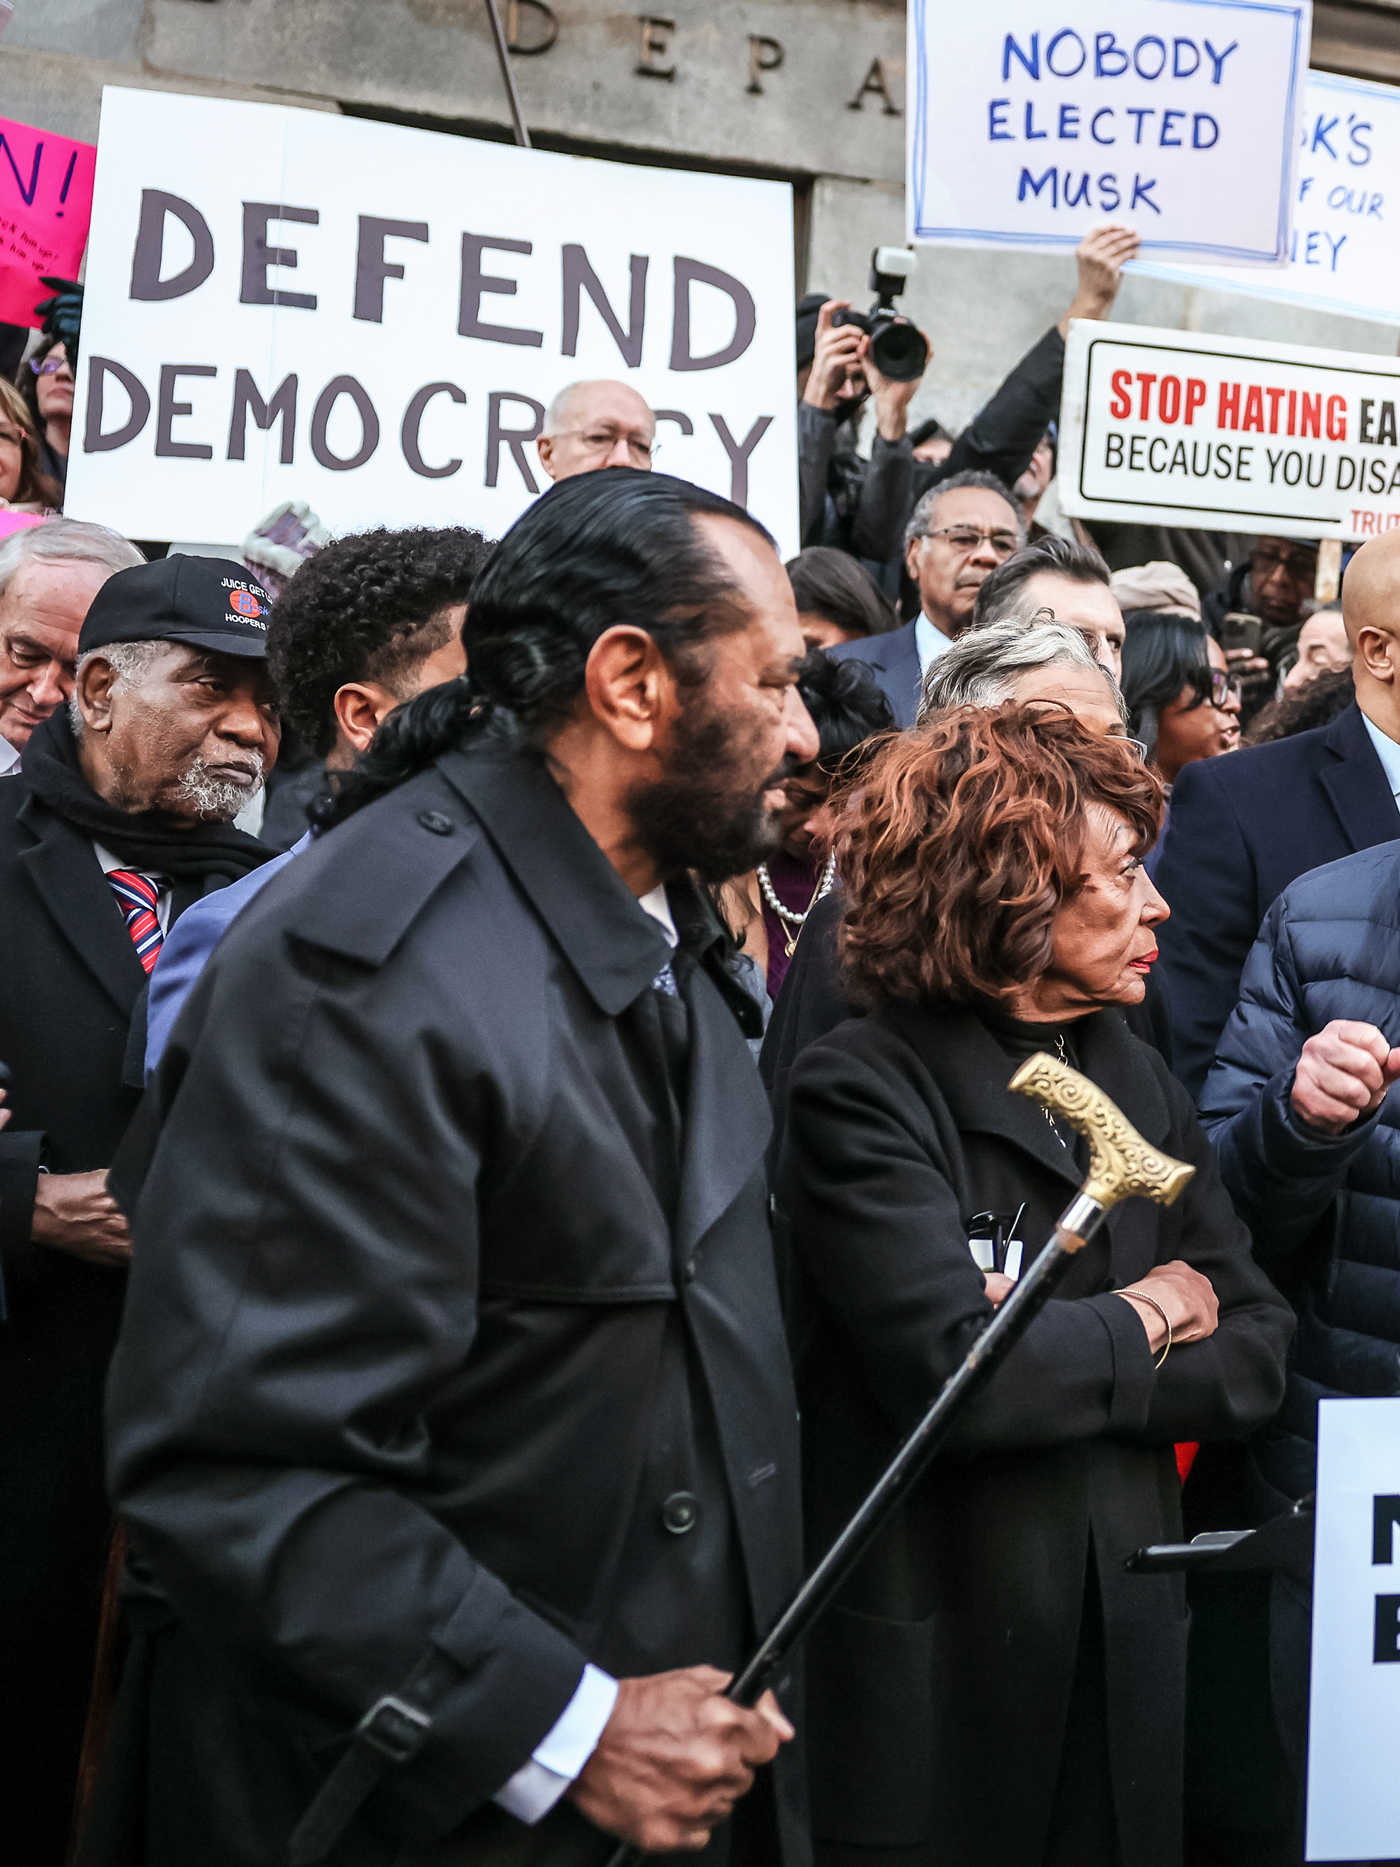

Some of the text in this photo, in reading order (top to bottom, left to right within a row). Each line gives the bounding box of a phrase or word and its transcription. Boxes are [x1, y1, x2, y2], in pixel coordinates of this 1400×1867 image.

[1001, 27, 1237, 85] NOBODY
[988, 98, 1219, 149] ELECTED
[1301, 113, 1372, 167] K'S
[1017, 167, 1160, 213] MUSK
[1327, 185, 1385, 222] OUR
[1291, 229, 1347, 272] EY
[129, 188, 756, 372] DEFEND
[83, 355, 775, 510] DEMOCRY
[1109, 368, 1207, 426] STOP
[1217, 380, 1348, 442] HATING
[1105, 433, 1254, 482] BECAUSE
[1266, 448, 1326, 489] YOU
